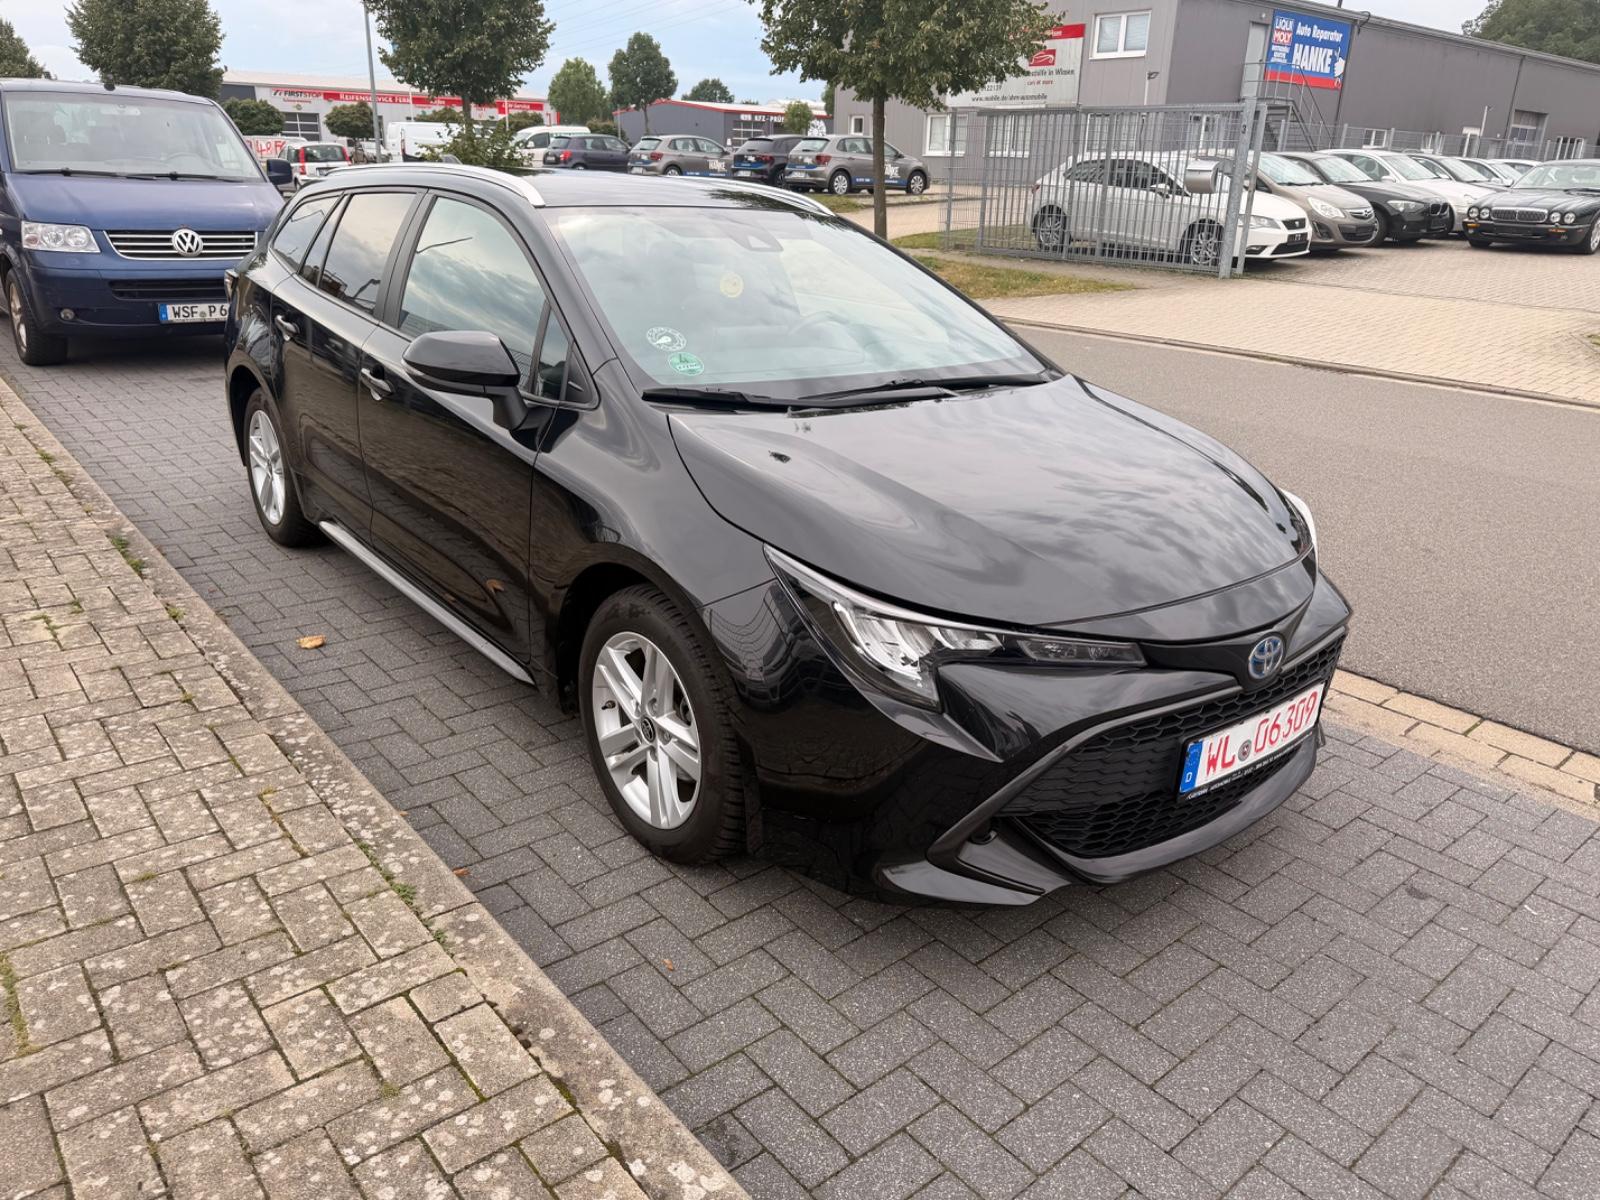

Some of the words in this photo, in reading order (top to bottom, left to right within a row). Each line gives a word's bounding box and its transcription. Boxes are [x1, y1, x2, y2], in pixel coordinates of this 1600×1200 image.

[1273, 31, 1293, 43] MOLY
[1296, 22, 1311, 37] Auto
[1292, 43, 1333, 73] HANKE
[172, 305, 199, 318] WSF
[1206, 735, 1236, 777] WL
[1254, 690, 1318, 753] 06309
